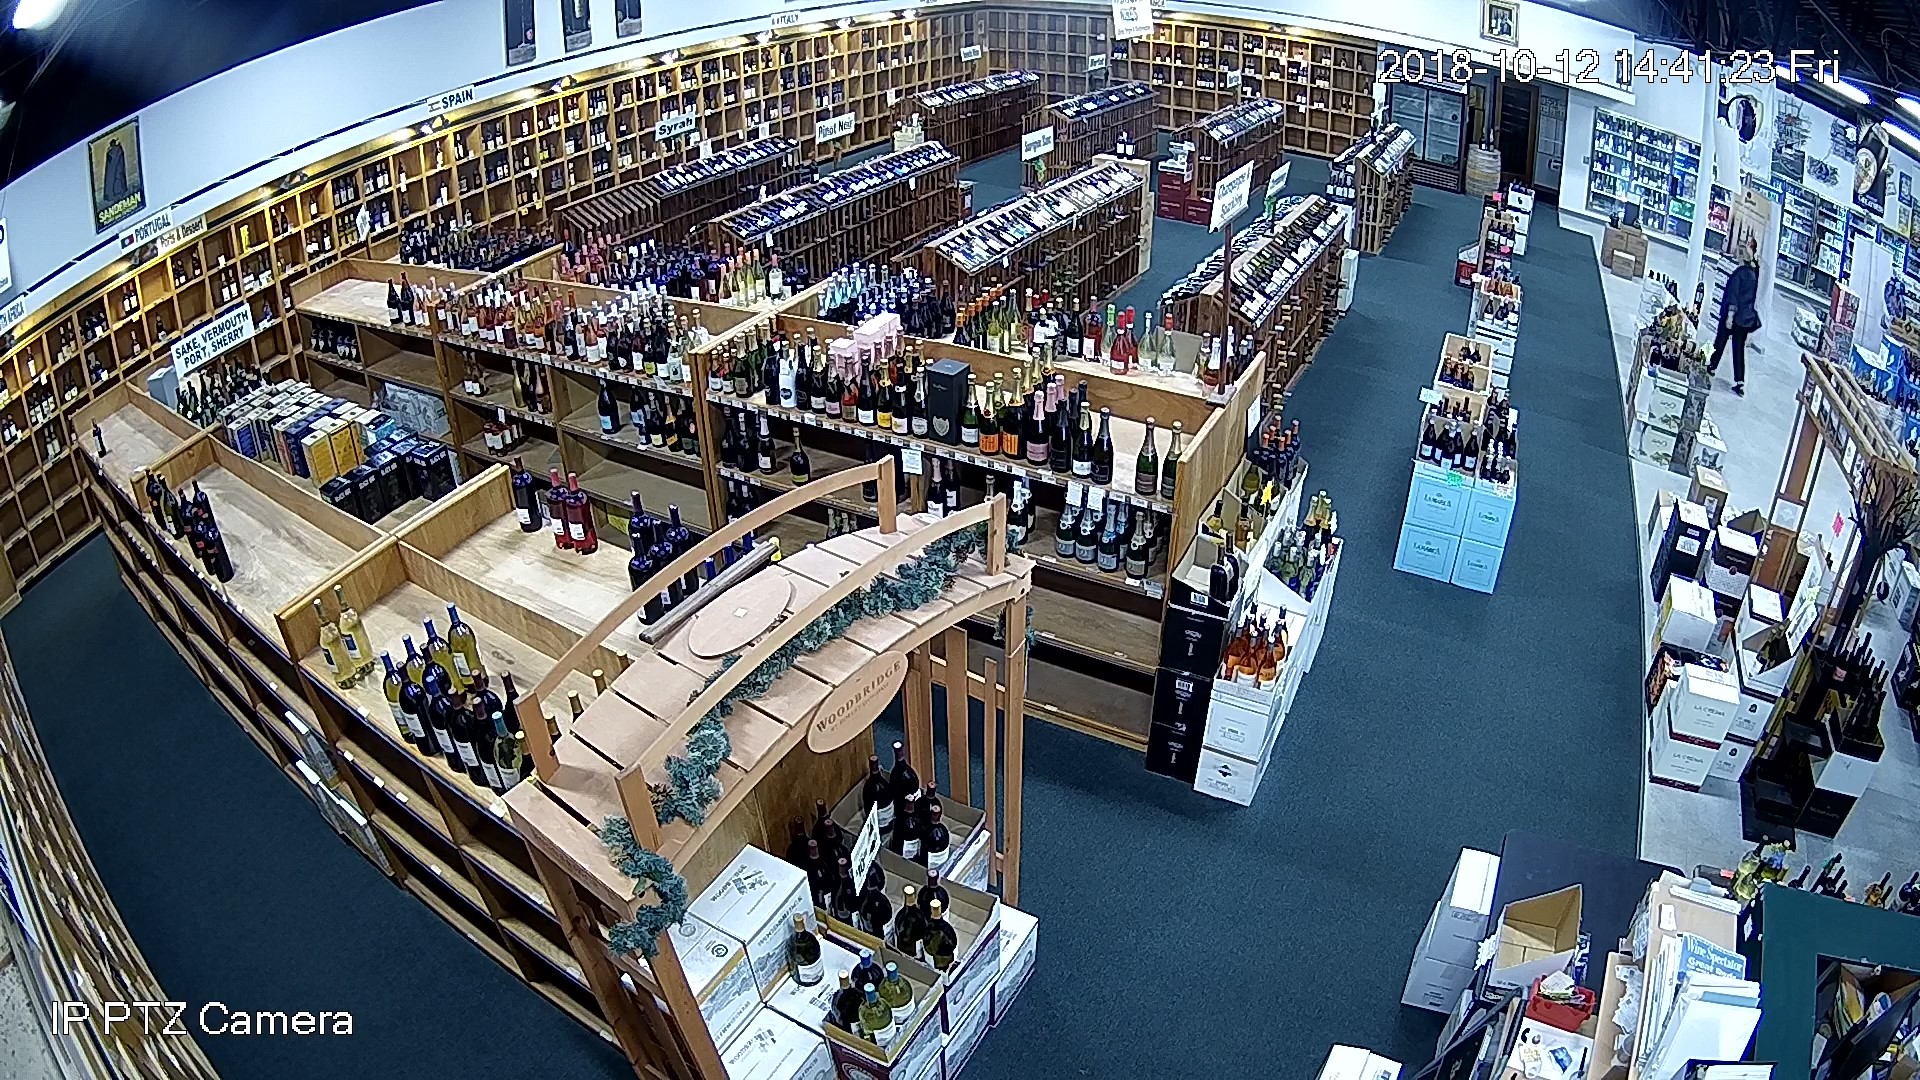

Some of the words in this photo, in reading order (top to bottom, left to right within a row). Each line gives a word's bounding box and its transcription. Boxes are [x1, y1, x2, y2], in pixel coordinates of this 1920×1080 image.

[780, 14, 799, 25] ITALY
[441, 88, 474, 110] SPAIN
[658, 117, 693, 136] Syrah
[98, 191, 142, 223] SANDEMAN
[134, 213, 171, 242] PORTUGAL
[181, 217, 204, 239] Dessert
[175, 337, 201, 359] SAKE,
[201, 309, 249, 343] VERMOUTH
[184, 345, 211, 368] PORT,
[211, 325, 244, 353] SHERRY
[816, 660, 902, 733] WOODBRIDGE
[1687, 934, 1707, 957] Wine
[1706, 945, 1743, 971] Spectator
